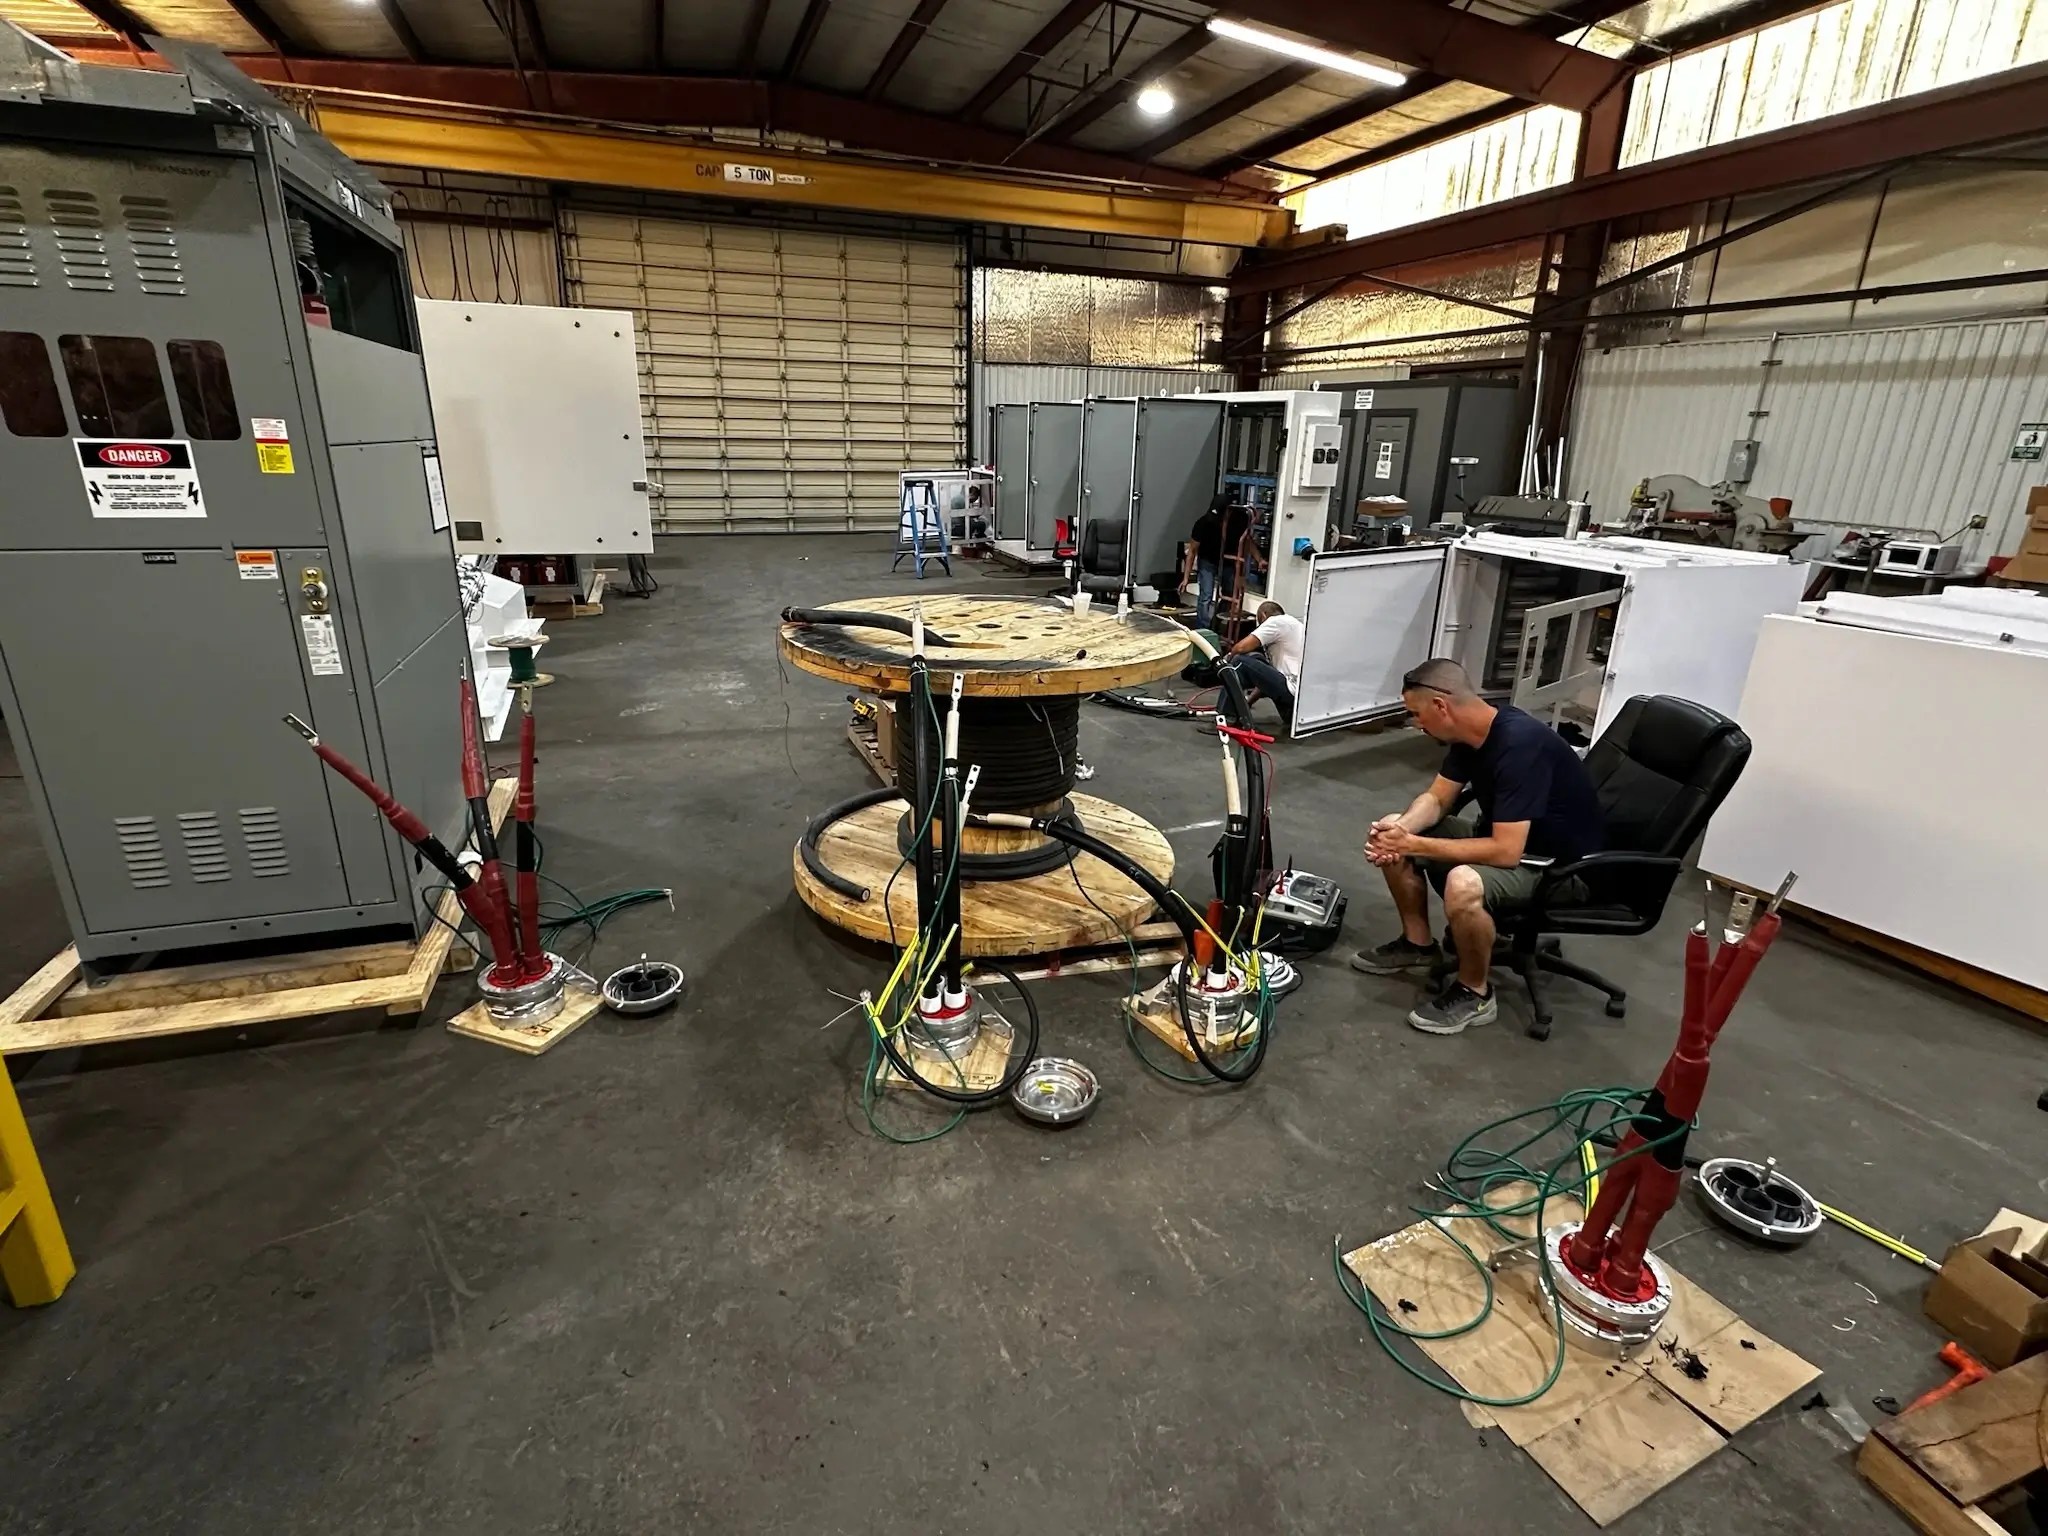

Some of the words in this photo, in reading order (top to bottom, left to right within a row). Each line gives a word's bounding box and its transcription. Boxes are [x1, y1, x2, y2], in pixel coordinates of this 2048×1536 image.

[696, 163, 721, 177] CAP
[734, 167, 742, 179] 5
[748, 168, 771, 182] TON
[107, 449, 164, 463] DANGER
